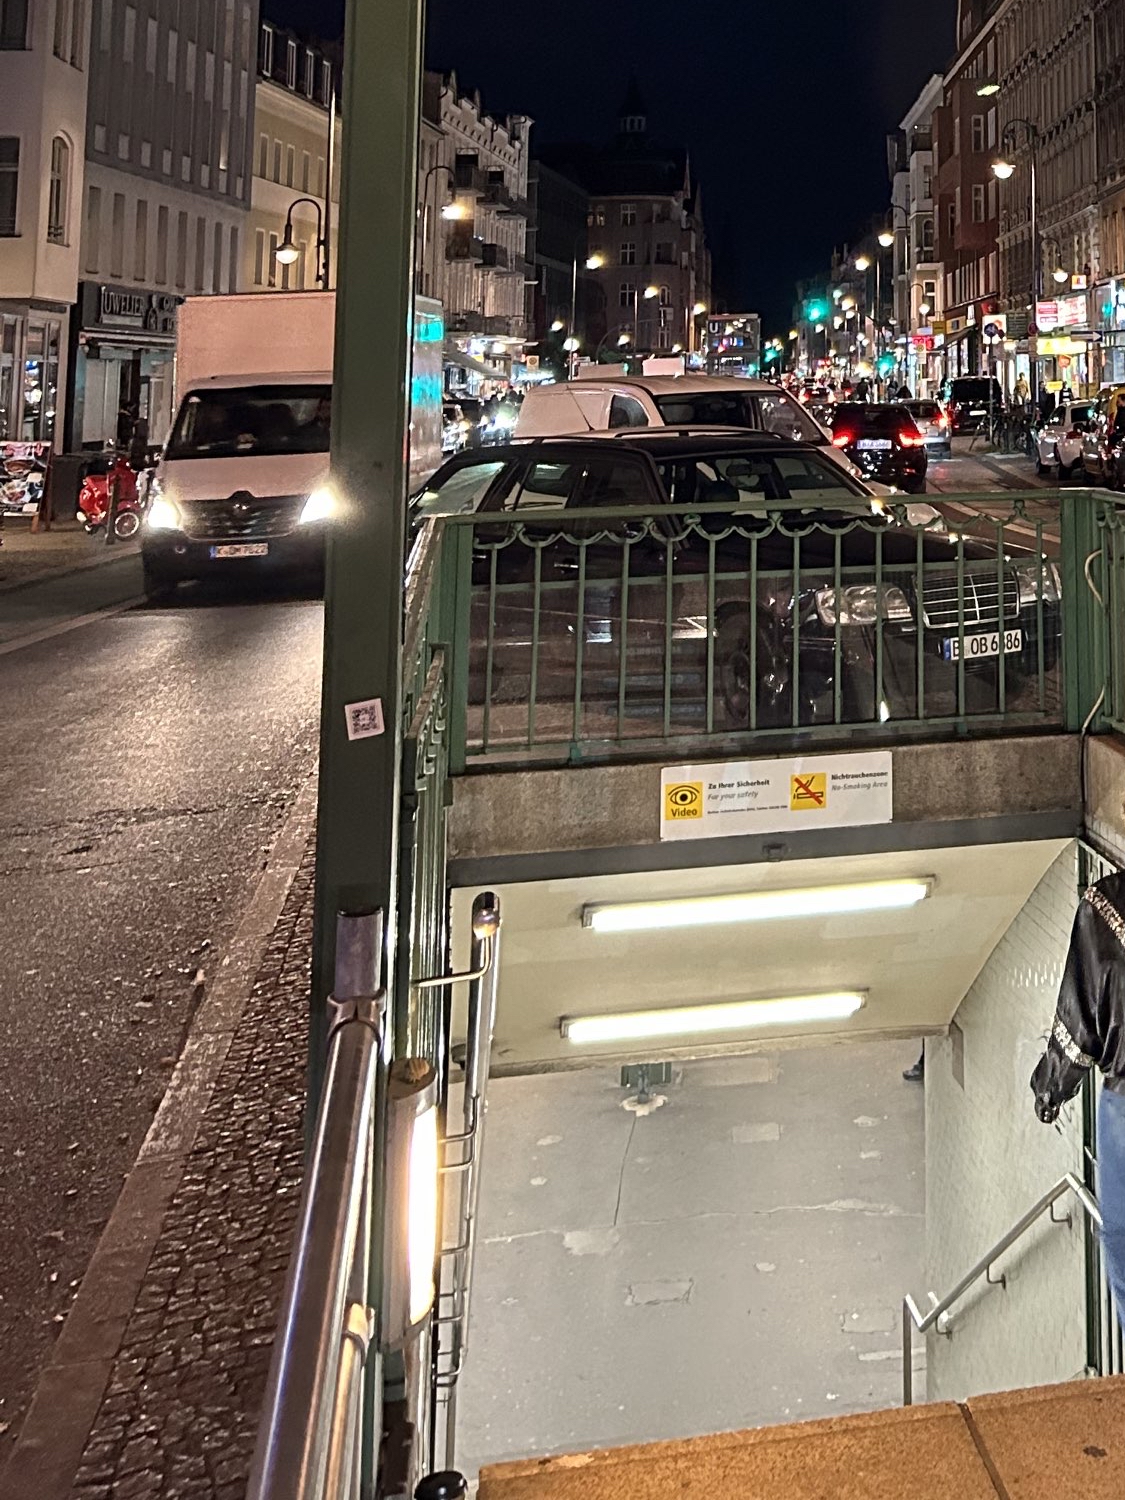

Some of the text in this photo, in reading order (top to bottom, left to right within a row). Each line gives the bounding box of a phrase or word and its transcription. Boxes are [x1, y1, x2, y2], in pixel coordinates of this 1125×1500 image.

[991, 632, 1020, 651] 686
[736, 779, 770, 788] Sicherheit
[720, 793, 736, 801] your
[737, 791, 758, 799] safety
[671, 808, 698, 818] Video
